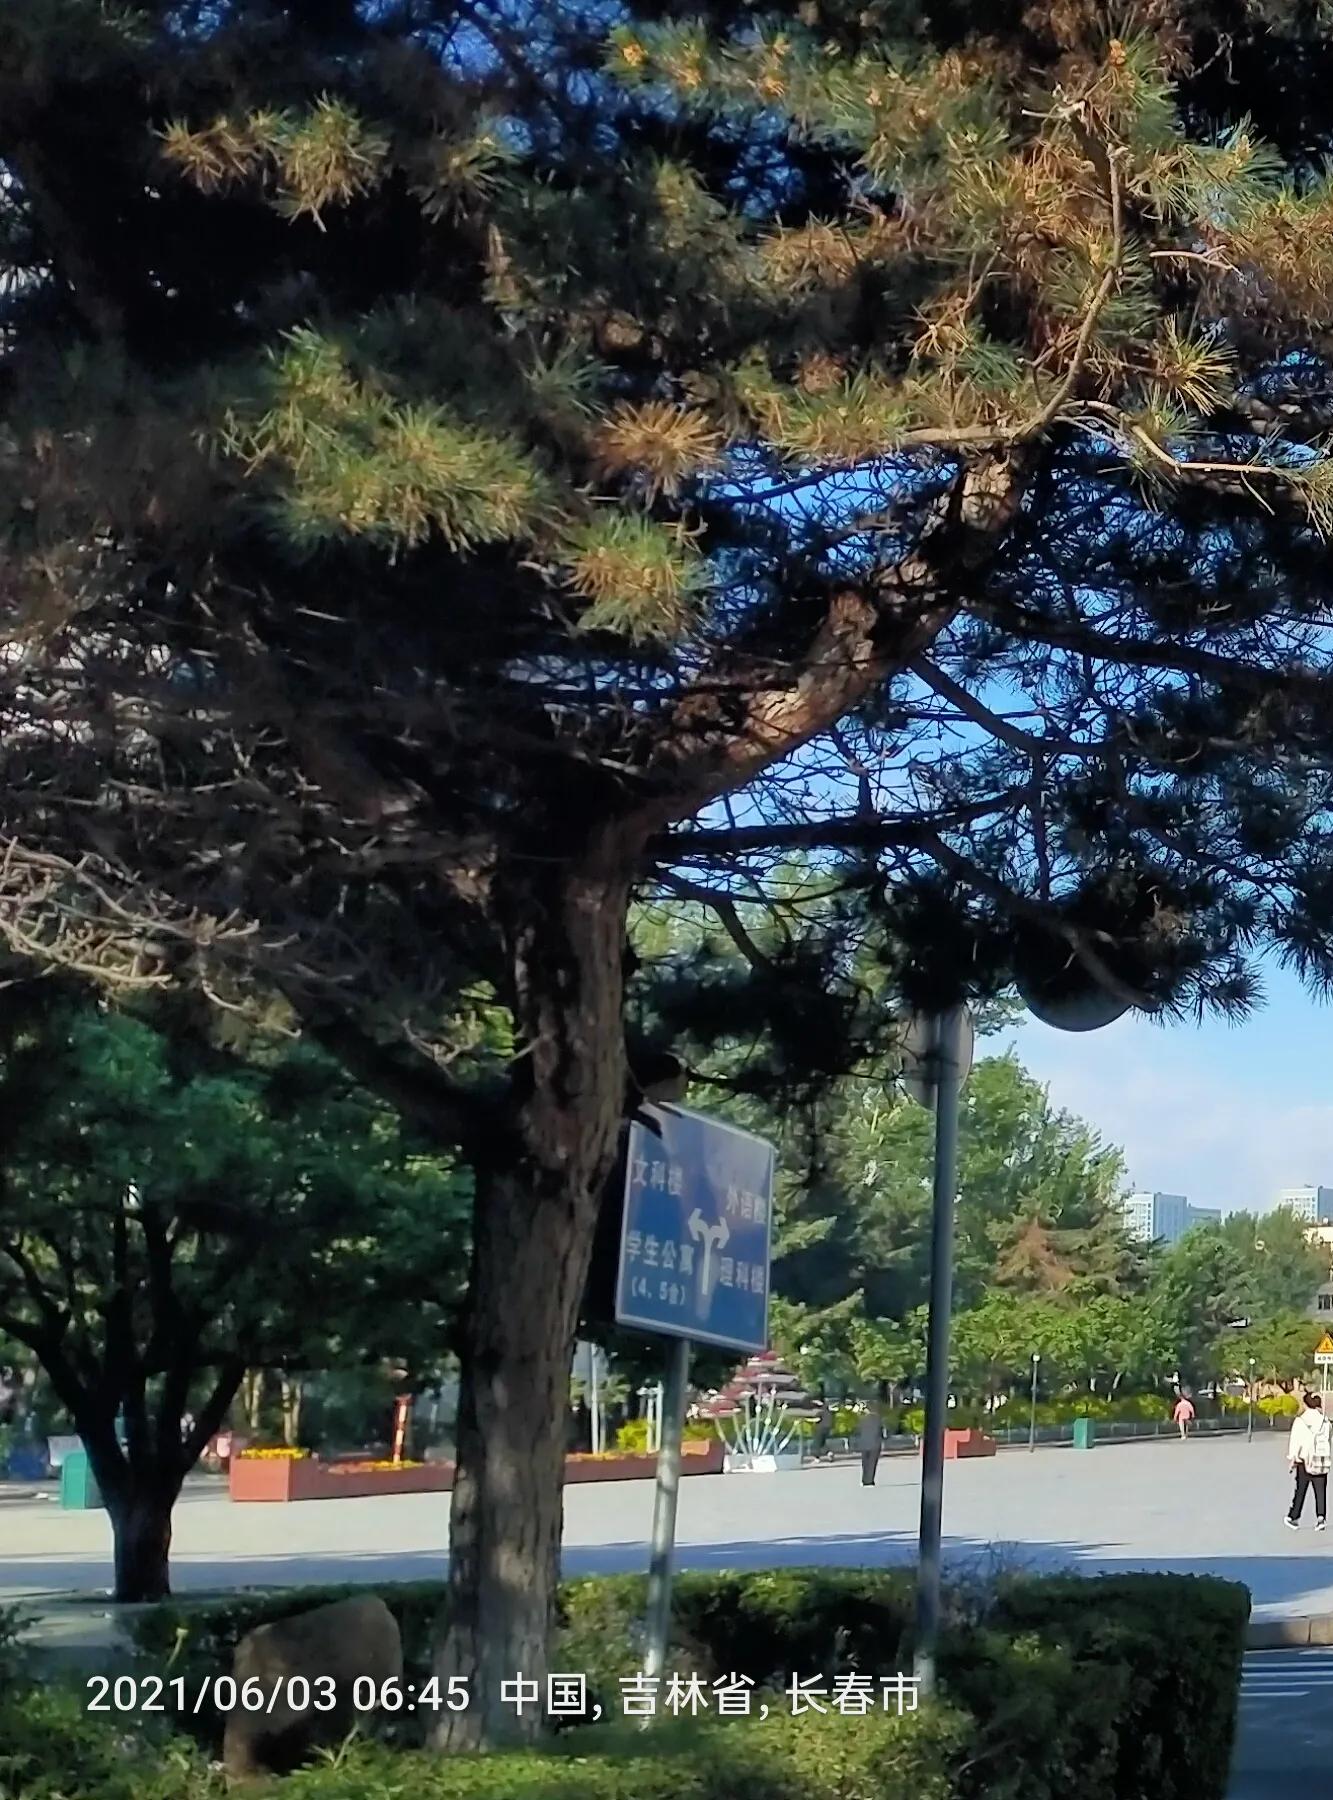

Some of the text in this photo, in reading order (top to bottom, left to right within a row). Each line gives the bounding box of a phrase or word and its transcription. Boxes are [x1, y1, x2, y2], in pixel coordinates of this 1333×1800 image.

[631, 1155, 683, 1196] 文科楼
[625, 1229, 695, 1277] 学生公寓
[719, 1255, 765, 1295] 理科楼
